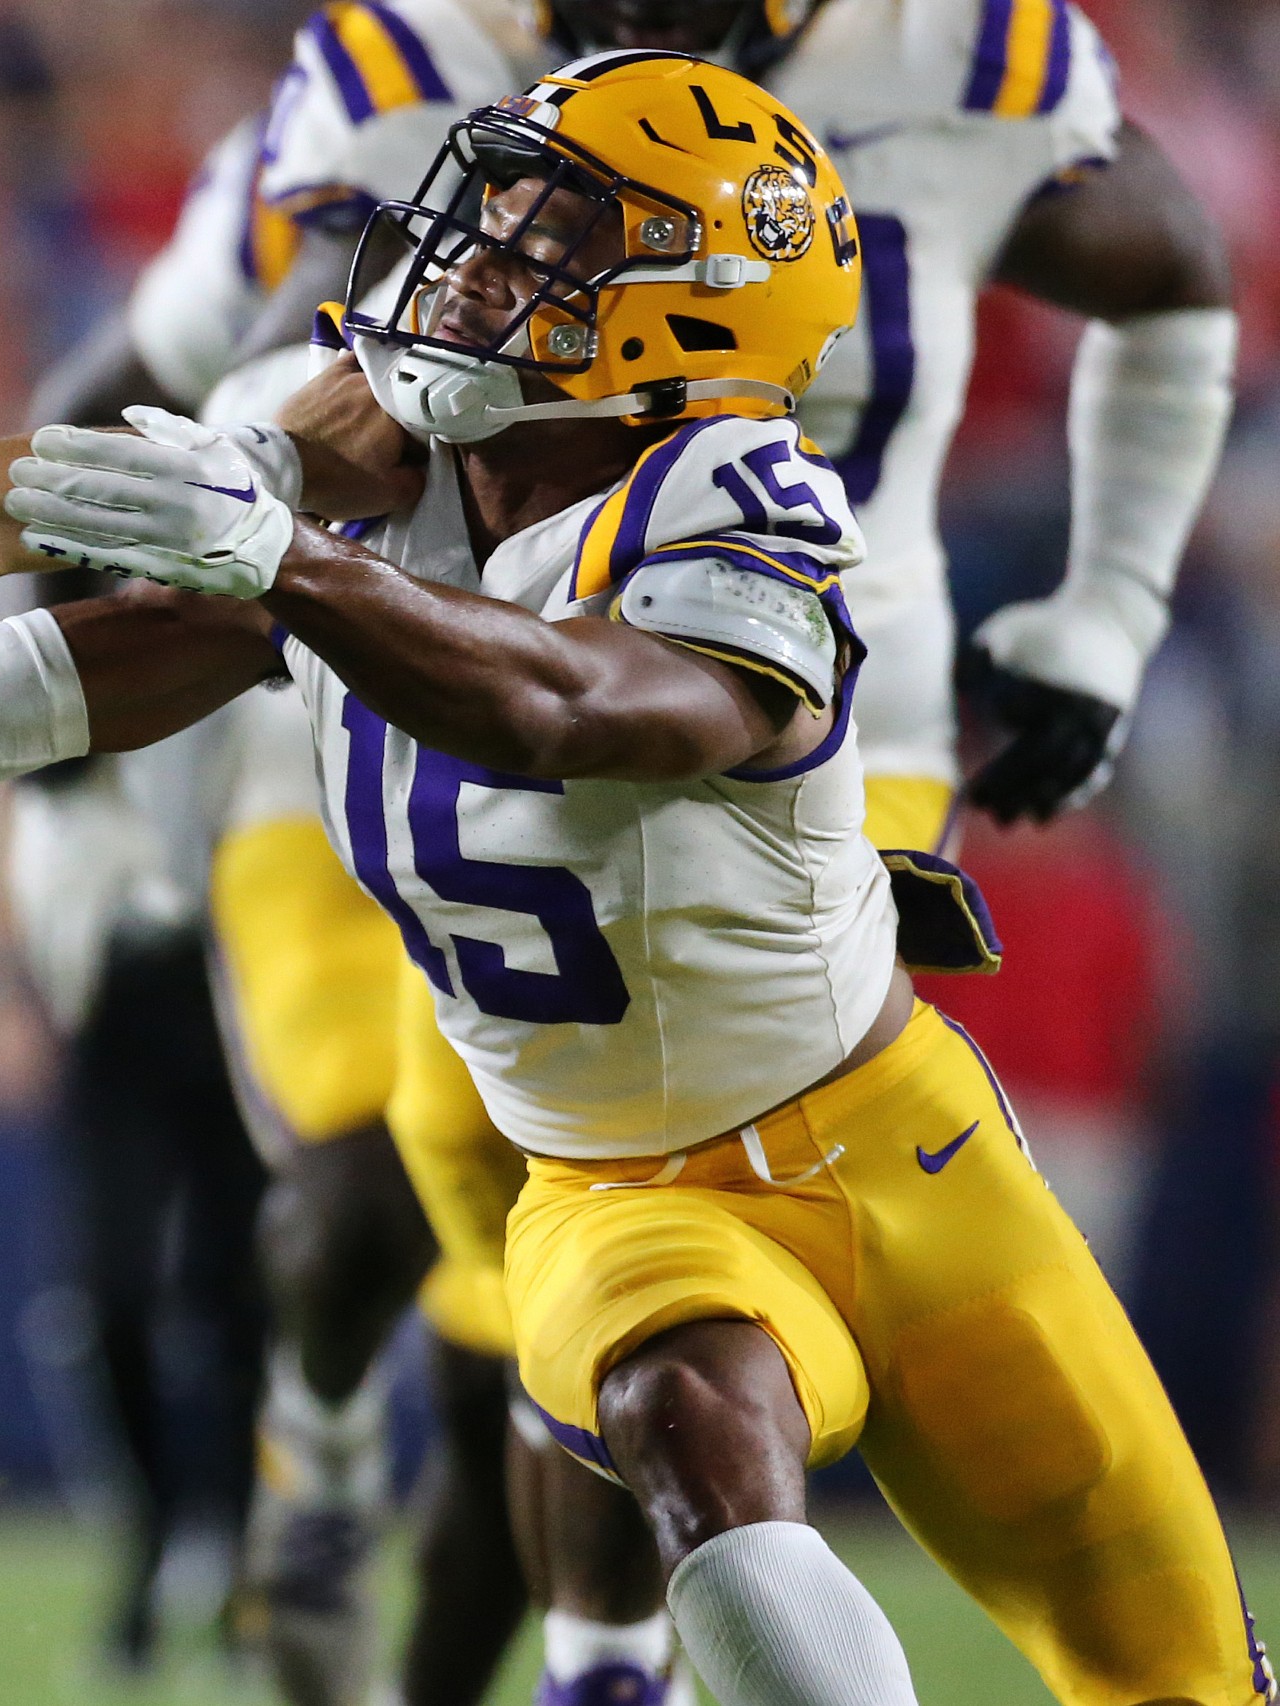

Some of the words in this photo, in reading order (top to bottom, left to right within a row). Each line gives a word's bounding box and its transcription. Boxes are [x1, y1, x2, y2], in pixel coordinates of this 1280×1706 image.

[688, 85, 858, 268] LSU
[712, 439, 842, 545] 15
[342, 690, 630, 1025] 15
